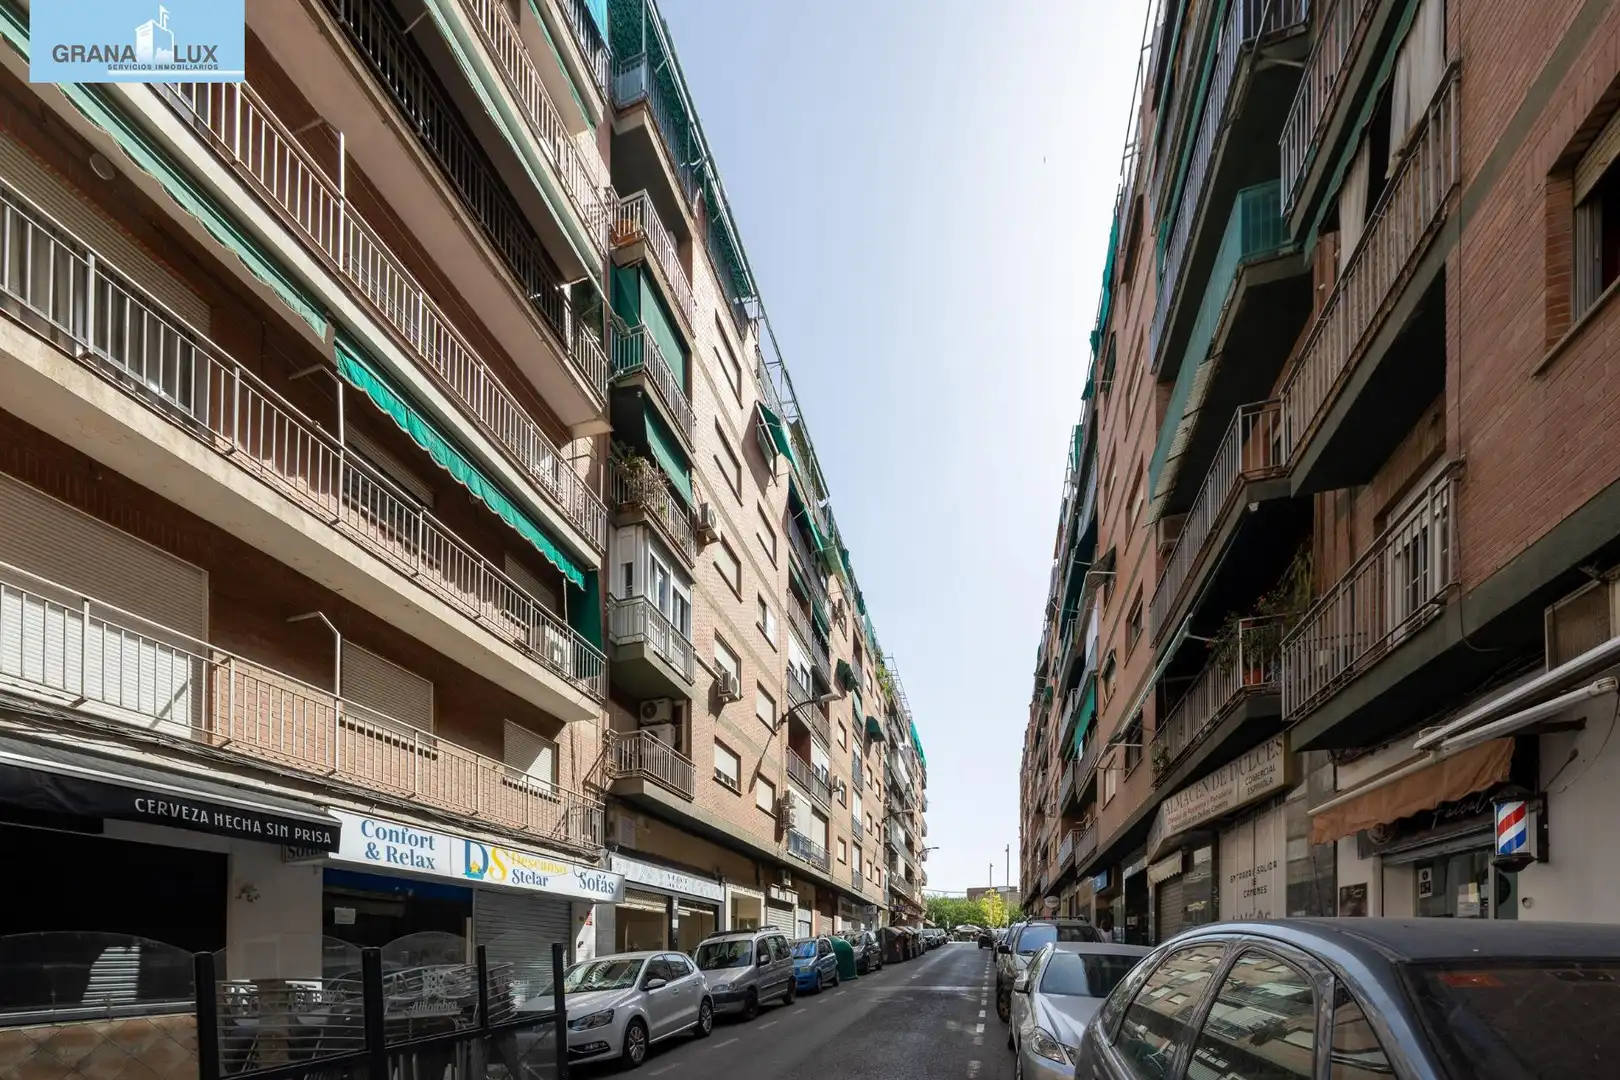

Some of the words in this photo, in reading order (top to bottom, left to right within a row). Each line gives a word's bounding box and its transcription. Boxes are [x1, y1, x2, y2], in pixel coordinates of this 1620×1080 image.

[1229, 738, 1283, 782] DULCES
[1244, 763, 1276, 786] COMERCIAL
[134, 798, 209, 824] CERVEZA
[213, 812, 262, 834] HECHA
[266, 822, 289, 838] SIN
[294, 827, 332, 844] PRISA
[361, 819, 436, 850] Confort
[364, 841, 381, 861] &
[386, 845, 436, 870] Relax
[511, 851, 568, 874] Descanso
[511, 868, 549, 887] Stelar
[579, 870, 615, 895] Sofás
